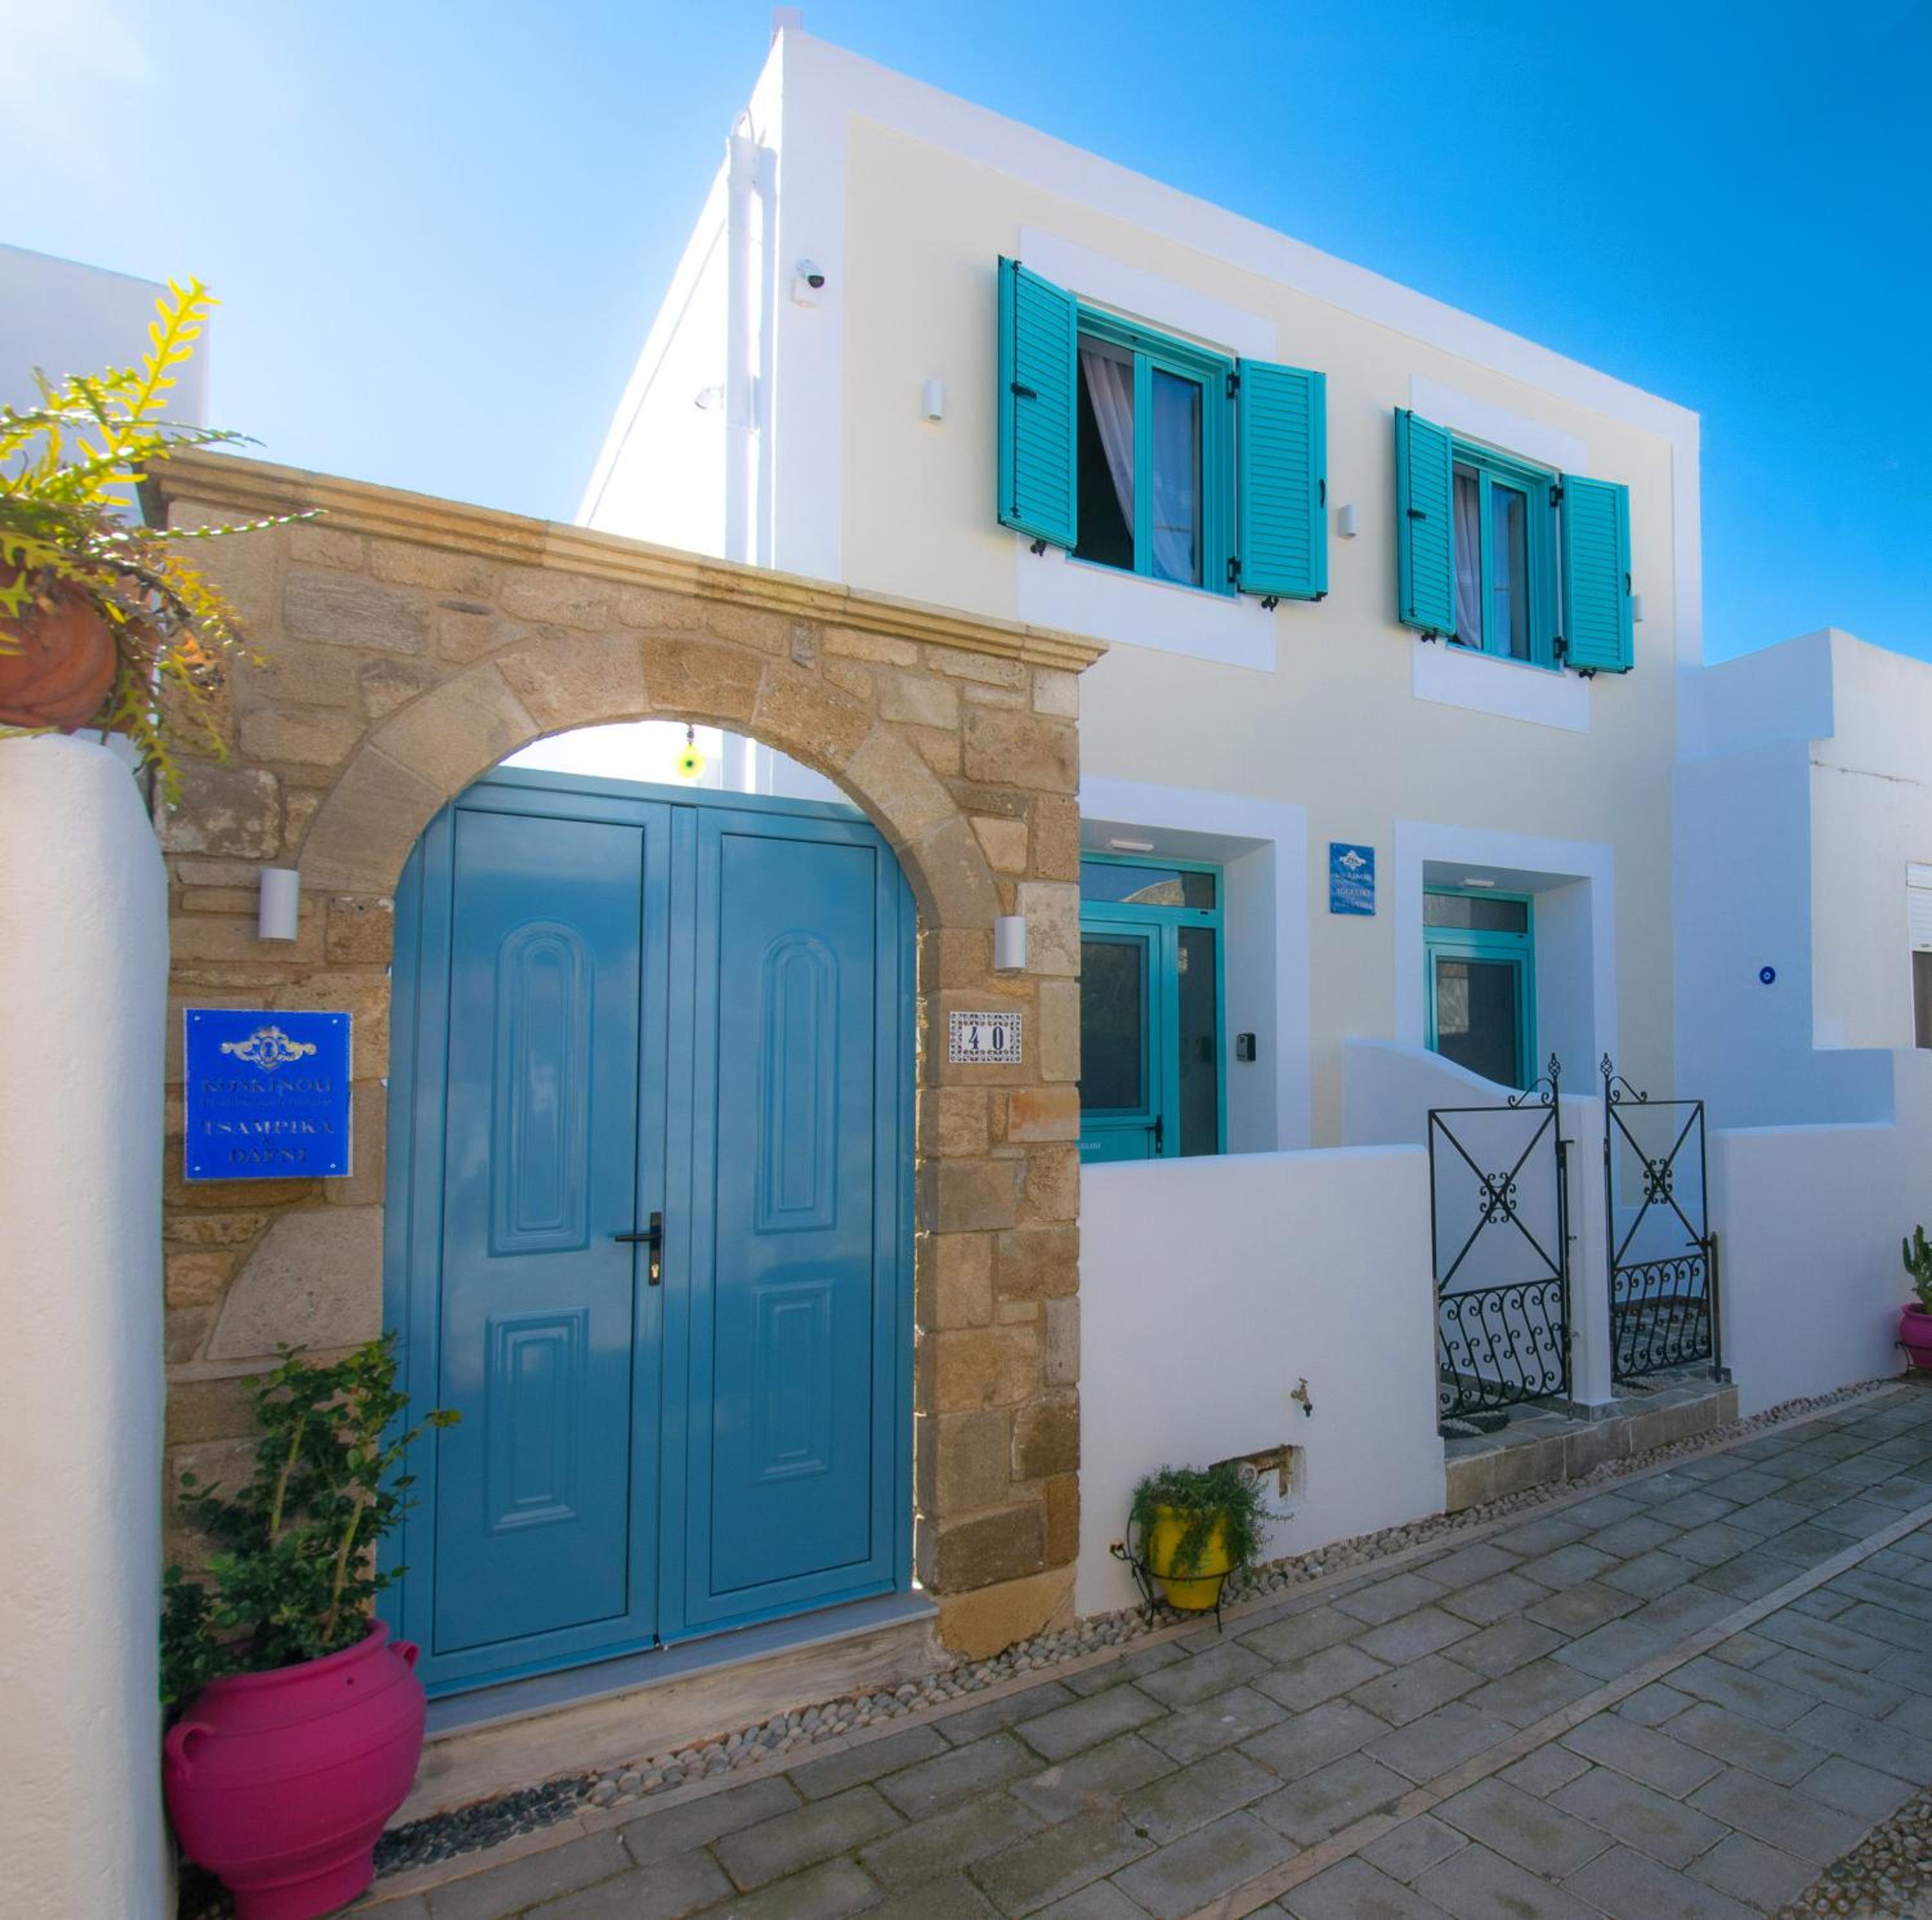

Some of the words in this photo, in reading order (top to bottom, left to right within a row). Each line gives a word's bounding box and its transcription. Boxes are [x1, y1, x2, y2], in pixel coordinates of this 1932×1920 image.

[968, 1026, 1004, 1050] 40
[203, 1078, 331, 1093] KOSKINOU
[202, 1120, 334, 1134] TSAMPIKA
[229, 1148, 306, 1163] DAFNI
